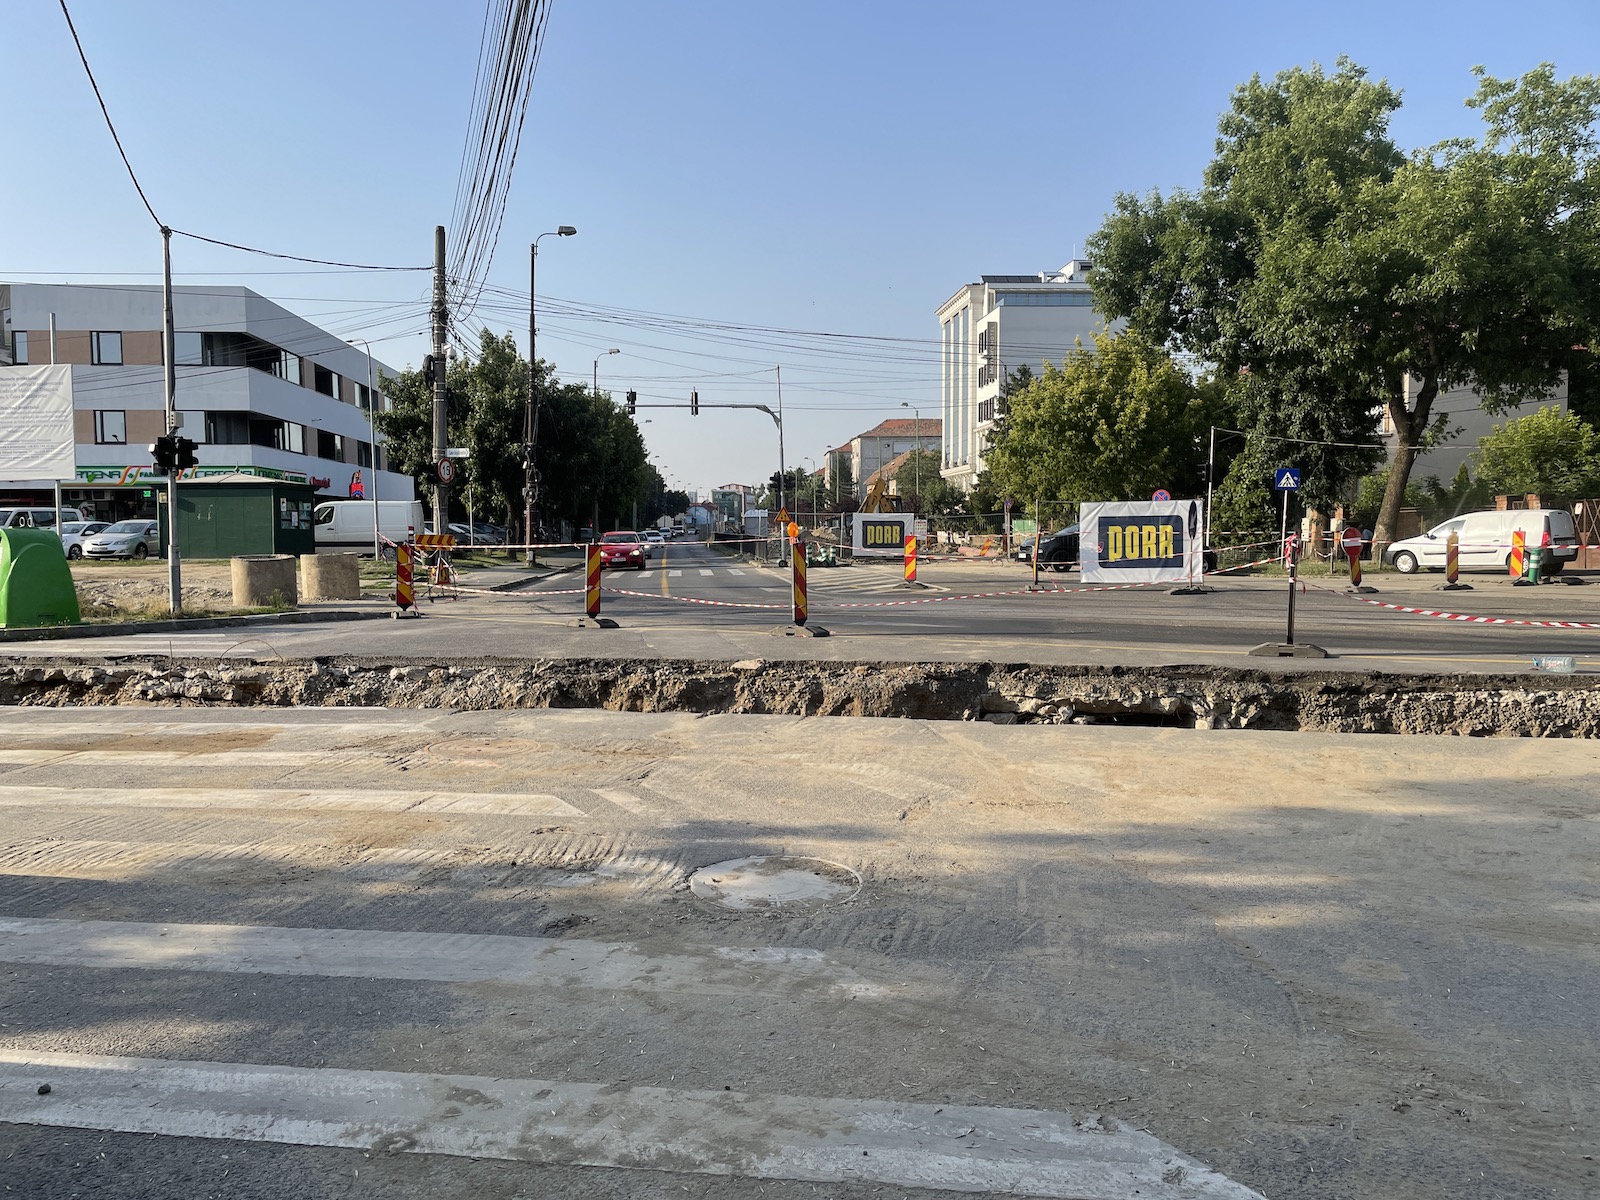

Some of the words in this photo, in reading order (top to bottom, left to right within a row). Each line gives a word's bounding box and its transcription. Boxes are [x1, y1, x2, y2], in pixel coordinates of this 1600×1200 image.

[76, 470, 121, 479] ATENA
[866, 525, 900, 545] PORR
[1108, 525, 1174, 562] PORR
